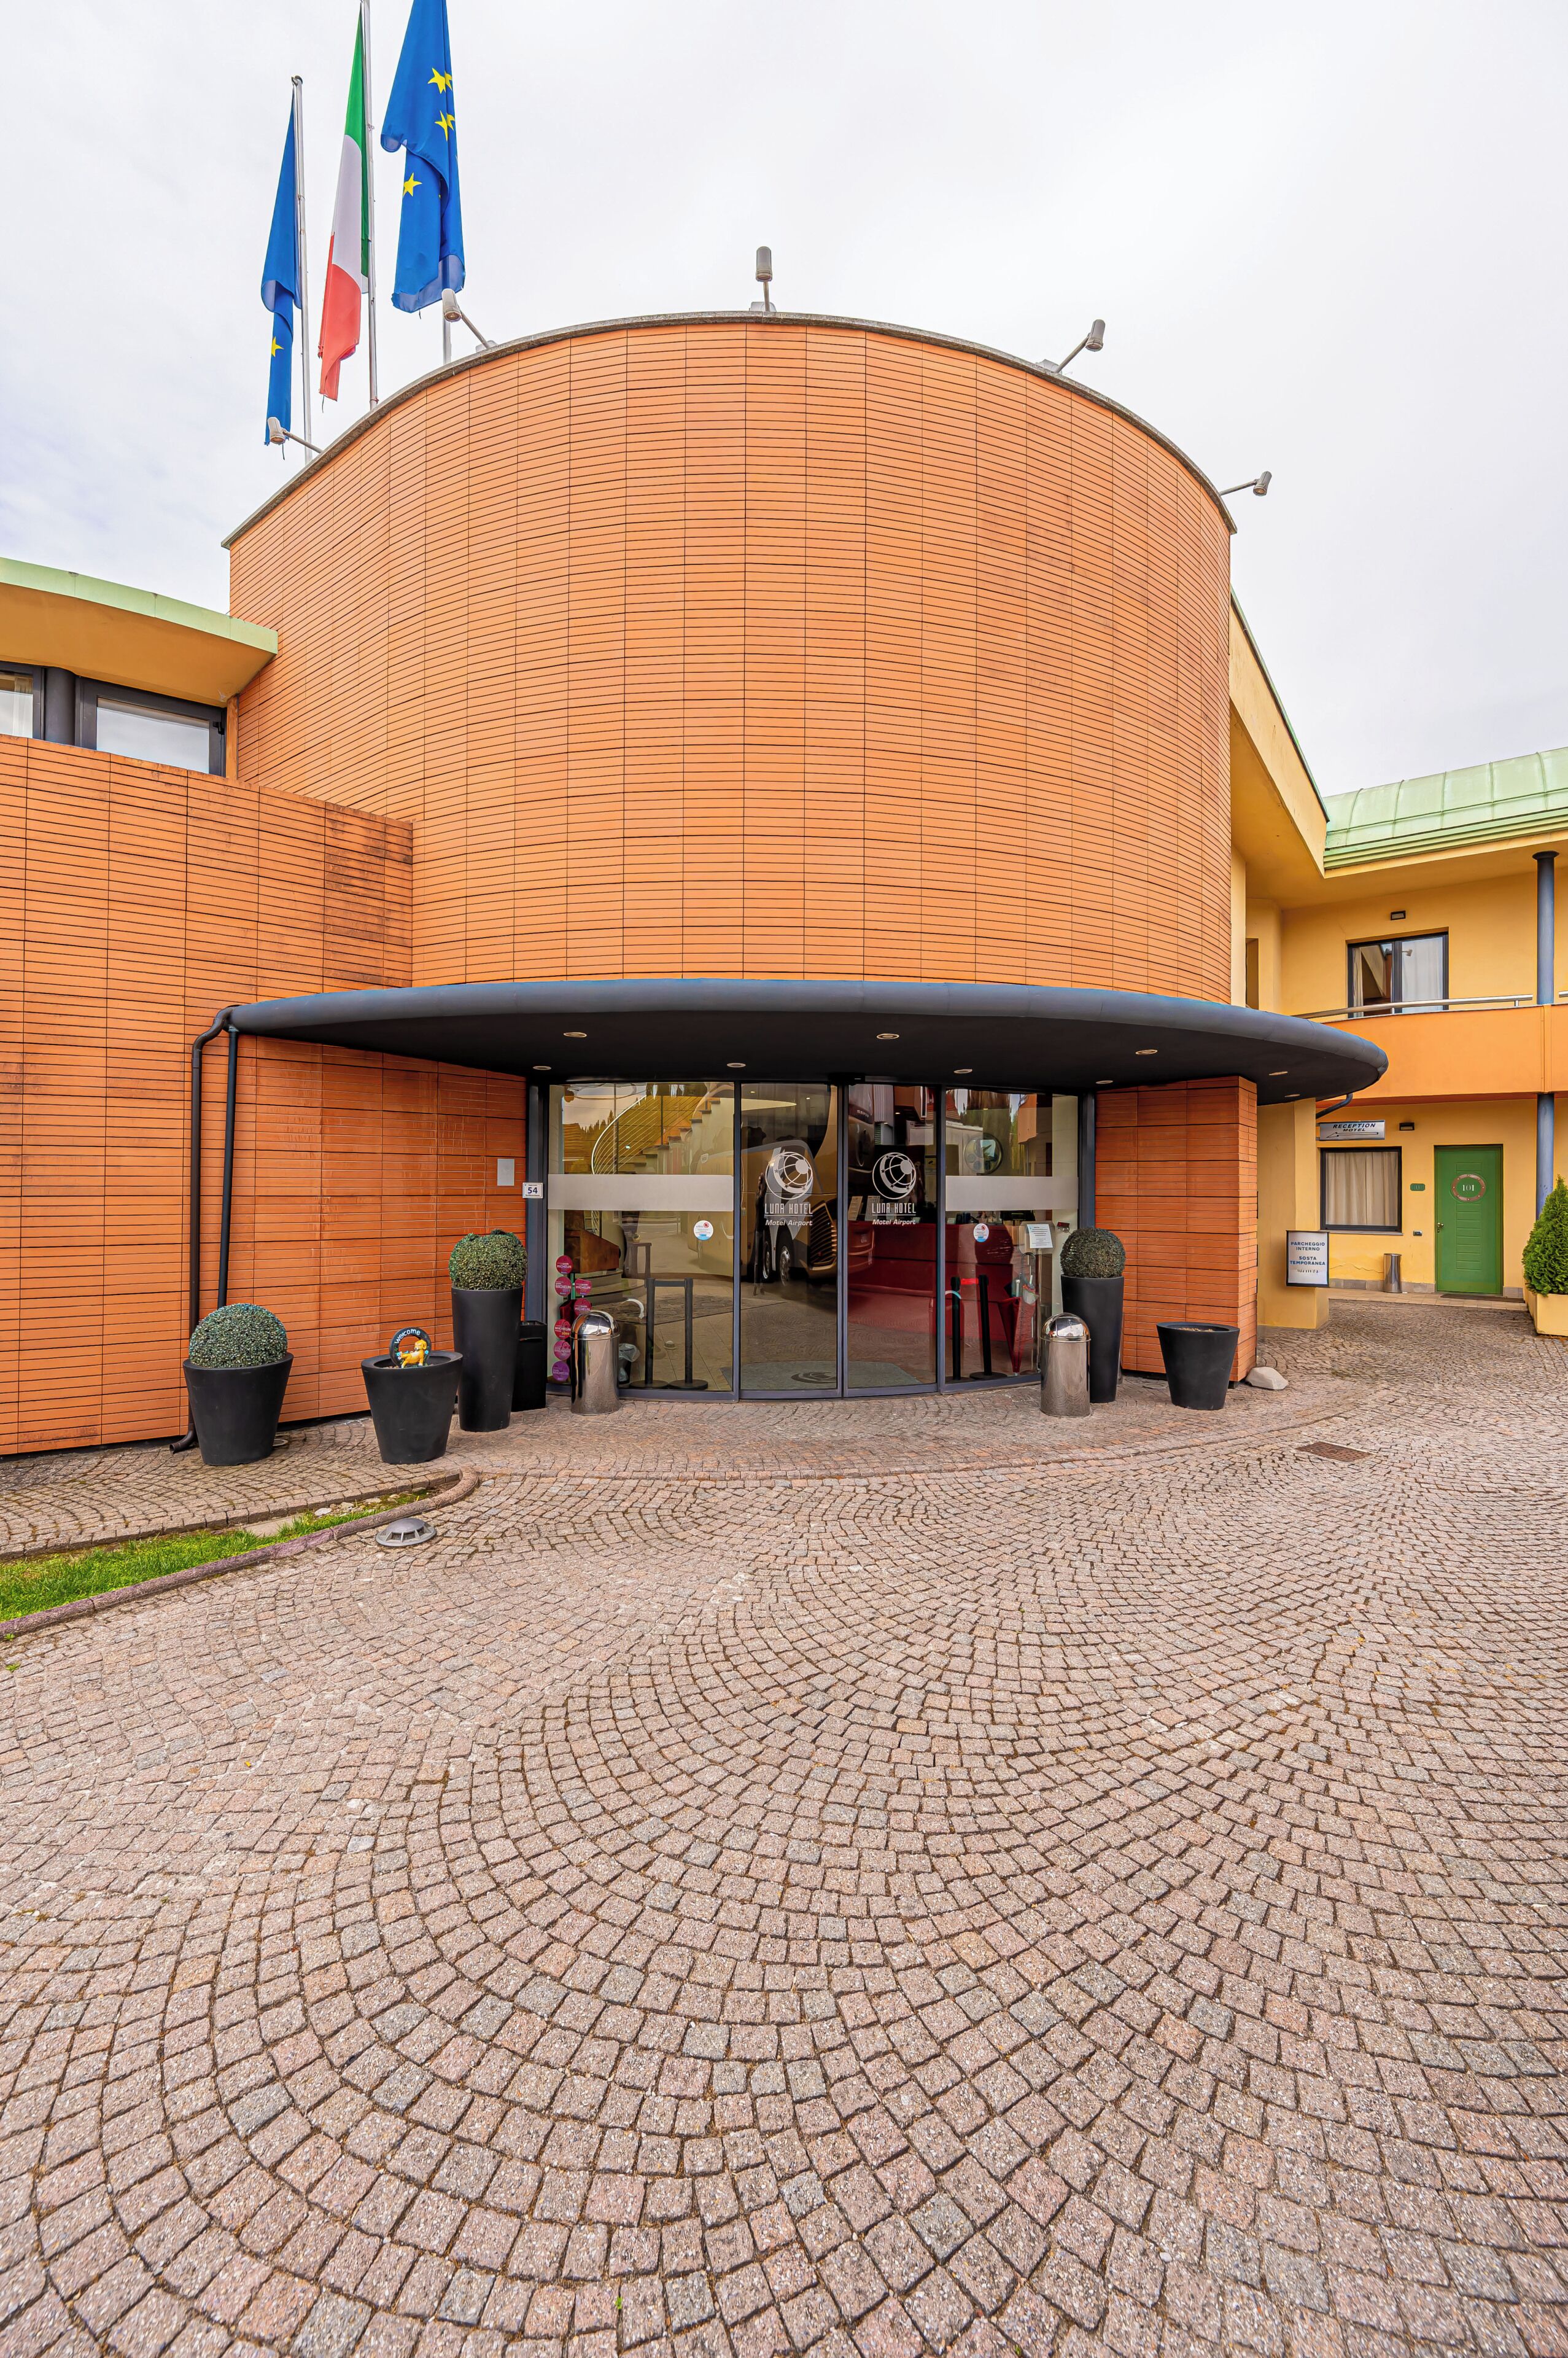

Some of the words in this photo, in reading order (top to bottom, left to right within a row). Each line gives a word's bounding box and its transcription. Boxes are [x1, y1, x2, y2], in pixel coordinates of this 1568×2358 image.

[764, 1203, 785, 1214] LUNA
[789, 1203, 813, 1214] HOTEL
[872, 1203, 890, 1213] LUNA
[895, 1203, 917, 1213] HOTEL
